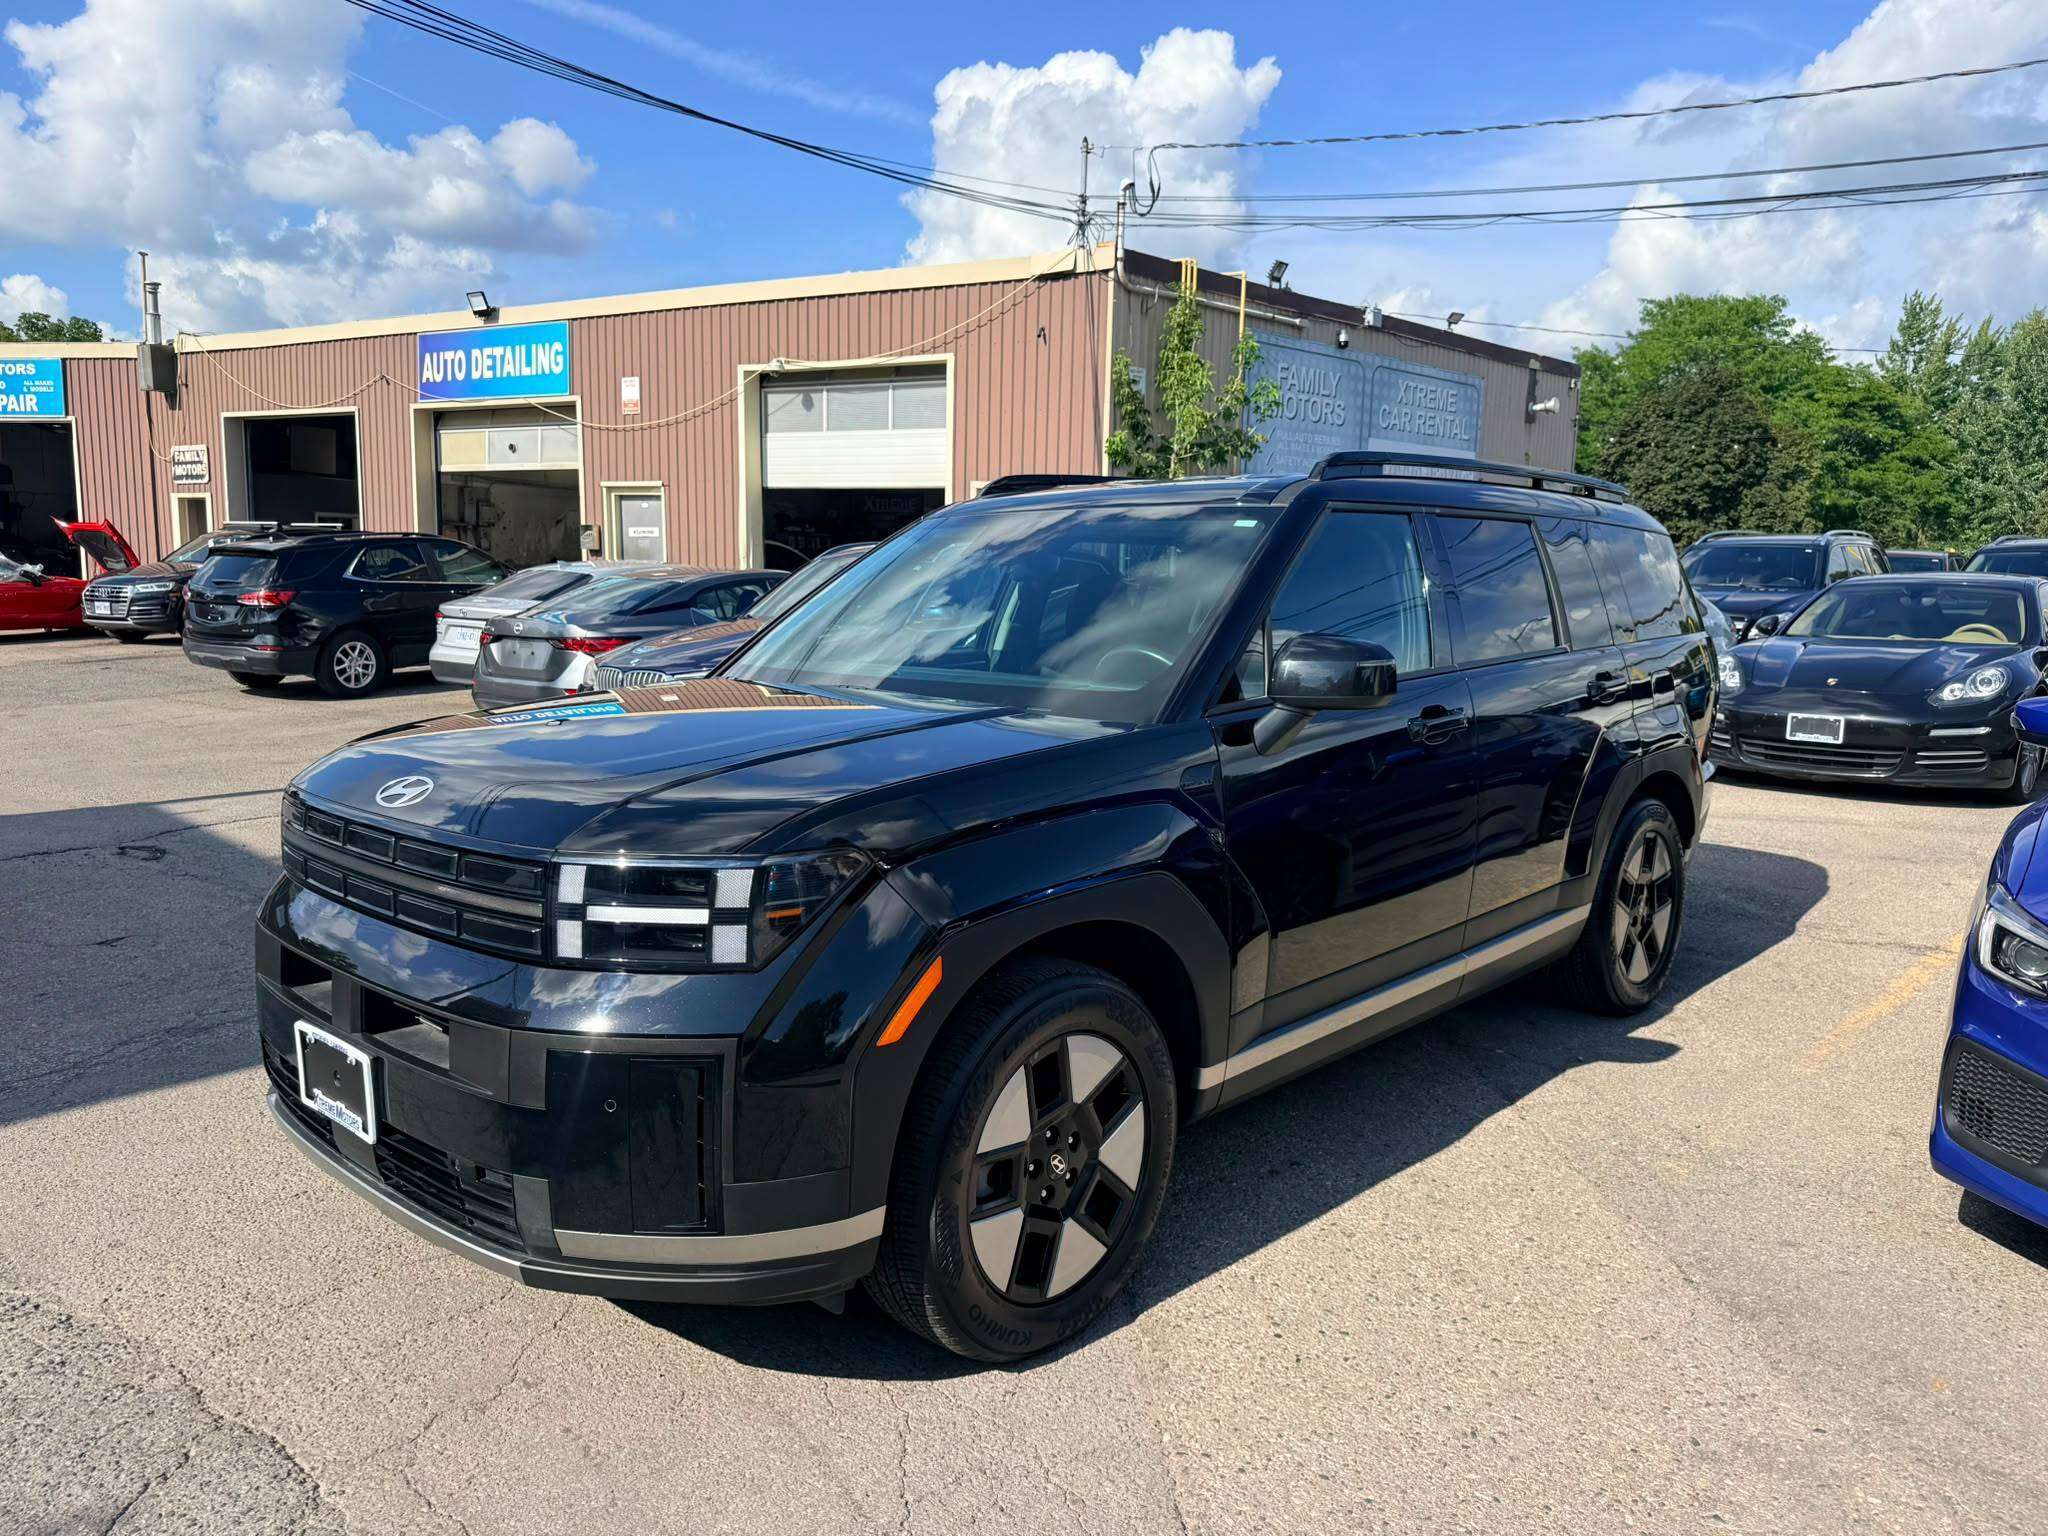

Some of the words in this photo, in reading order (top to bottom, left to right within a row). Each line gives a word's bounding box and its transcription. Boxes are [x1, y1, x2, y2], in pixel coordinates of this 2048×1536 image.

[421, 349, 466, 384] AUTO
[471, 341, 564, 380] DETAILING
[1279, 361, 1342, 398] FAMILY
[1397, 380, 1458, 414] XTREME
[1380, 404, 1412, 434] CAR
[1416, 412, 1471, 441] RENTAL
[174, 450, 205, 462] FAMILY
[174, 463, 207, 476] MOTORS
[968, 1303, 1033, 1346] KUMHO
